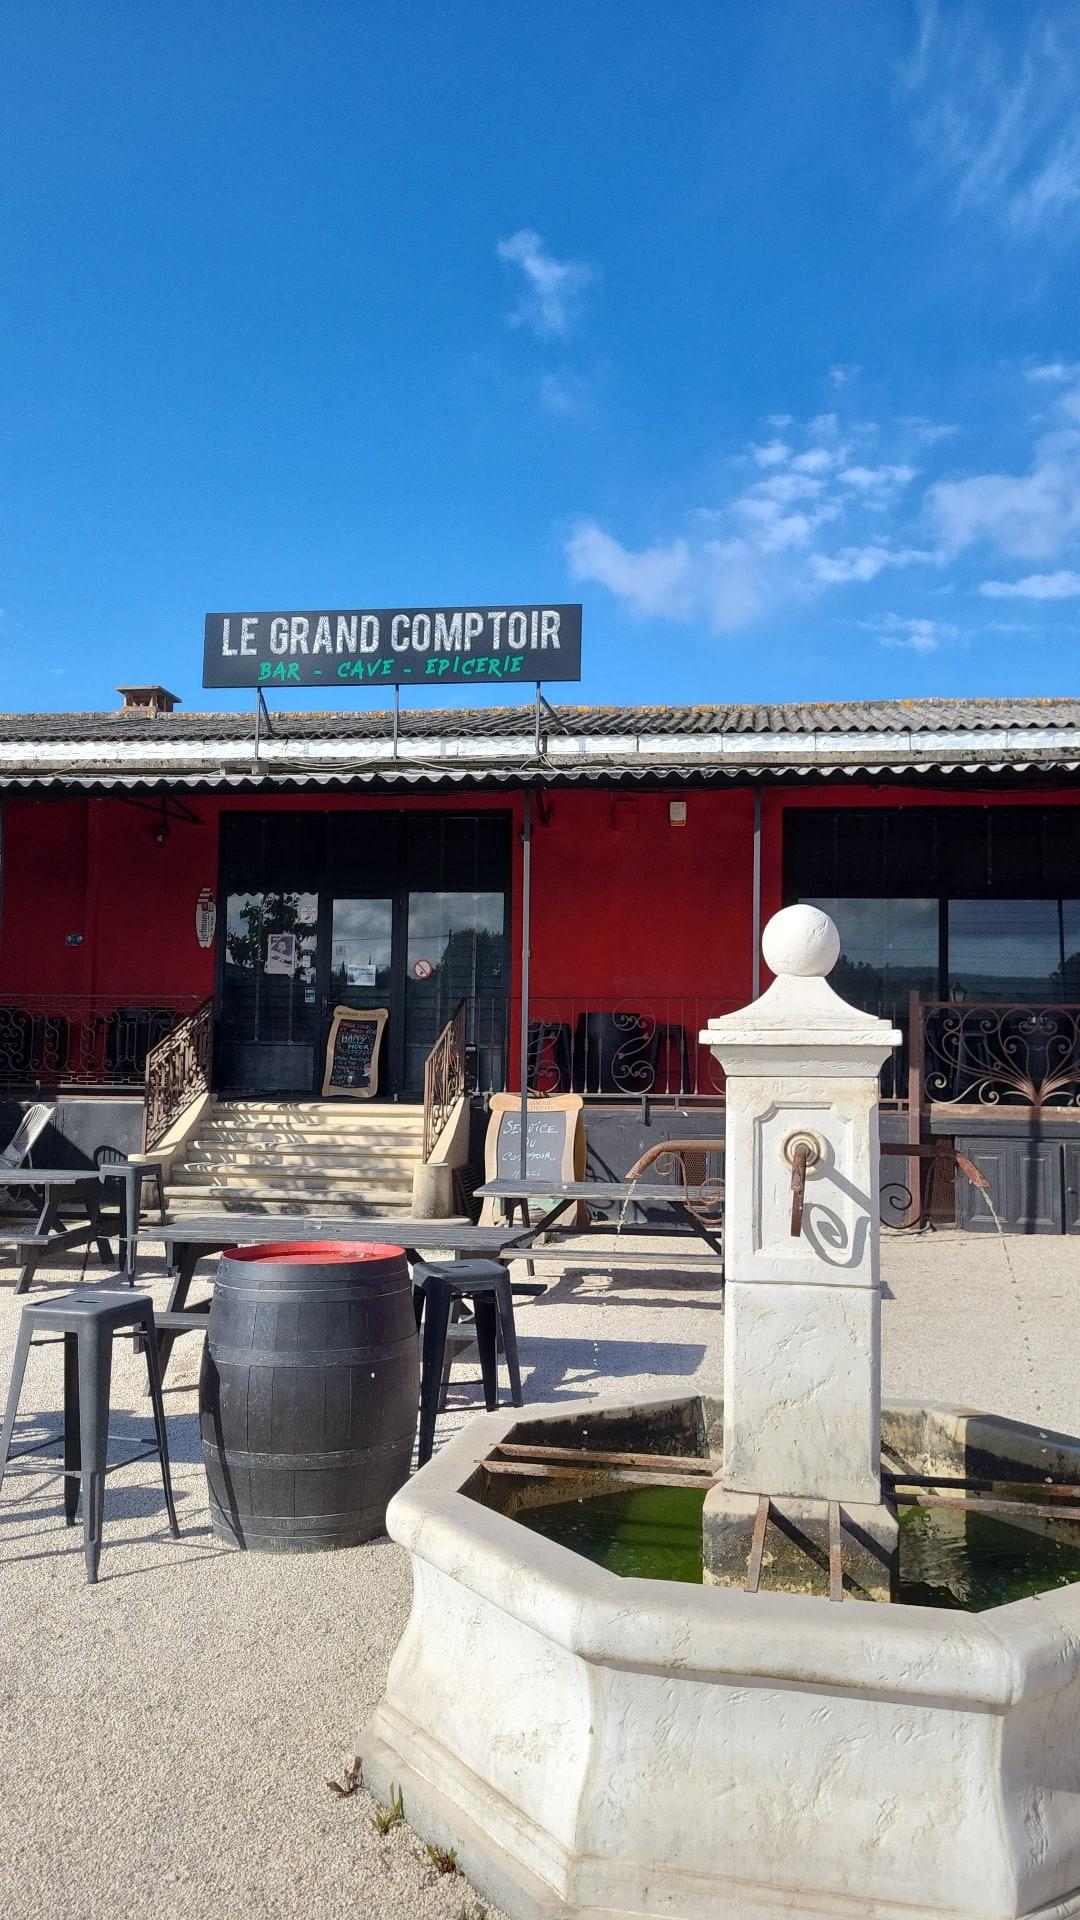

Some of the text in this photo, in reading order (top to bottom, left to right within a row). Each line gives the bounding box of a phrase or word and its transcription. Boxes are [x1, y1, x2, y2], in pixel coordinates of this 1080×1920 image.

[222, 610, 561, 656] LE GRAND COMPTOIR
[257, 661, 301, 681] BAR
[337, 659, 394, 680] CAVE
[425, 654, 524, 677] EPICERIE
[347, 1043, 370, 1051] HOUR
